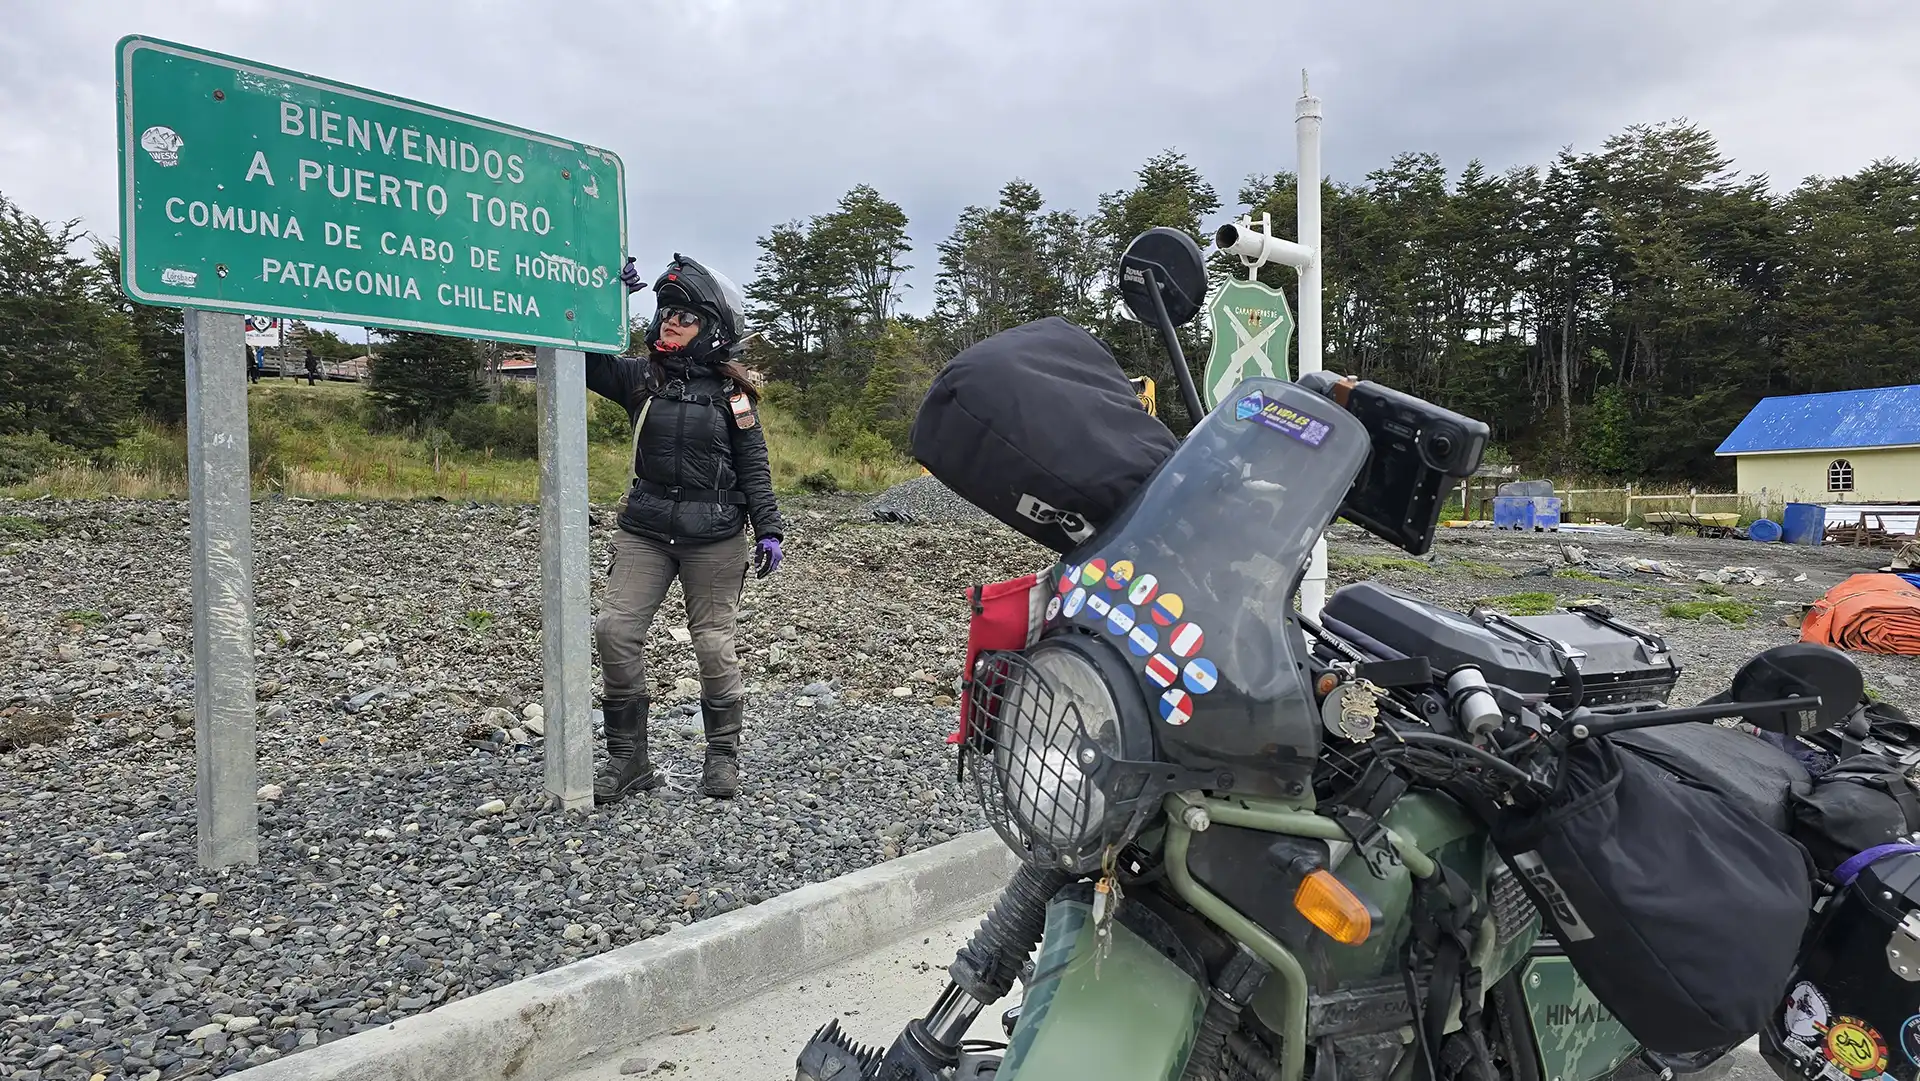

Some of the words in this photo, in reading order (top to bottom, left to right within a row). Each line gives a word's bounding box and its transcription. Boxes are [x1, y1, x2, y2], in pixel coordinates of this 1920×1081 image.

[280, 102, 525, 184] BIENVENIDOS
[245, 150, 275, 186] A
[299, 158, 449, 219] PUERTO
[466, 191, 551, 236] TORO
[165, 197, 305, 241] COMUNA
[324, 221, 362, 250] DE
[380, 231, 454, 265] CABO
[470, 246, 501, 272] DE
[515, 254, 605, 289] HORNOS
[262, 257, 422, 302] PATAGONIA
[437, 283, 540, 318] CHILENA
[1319, 629, 1340, 647] ROYAL
